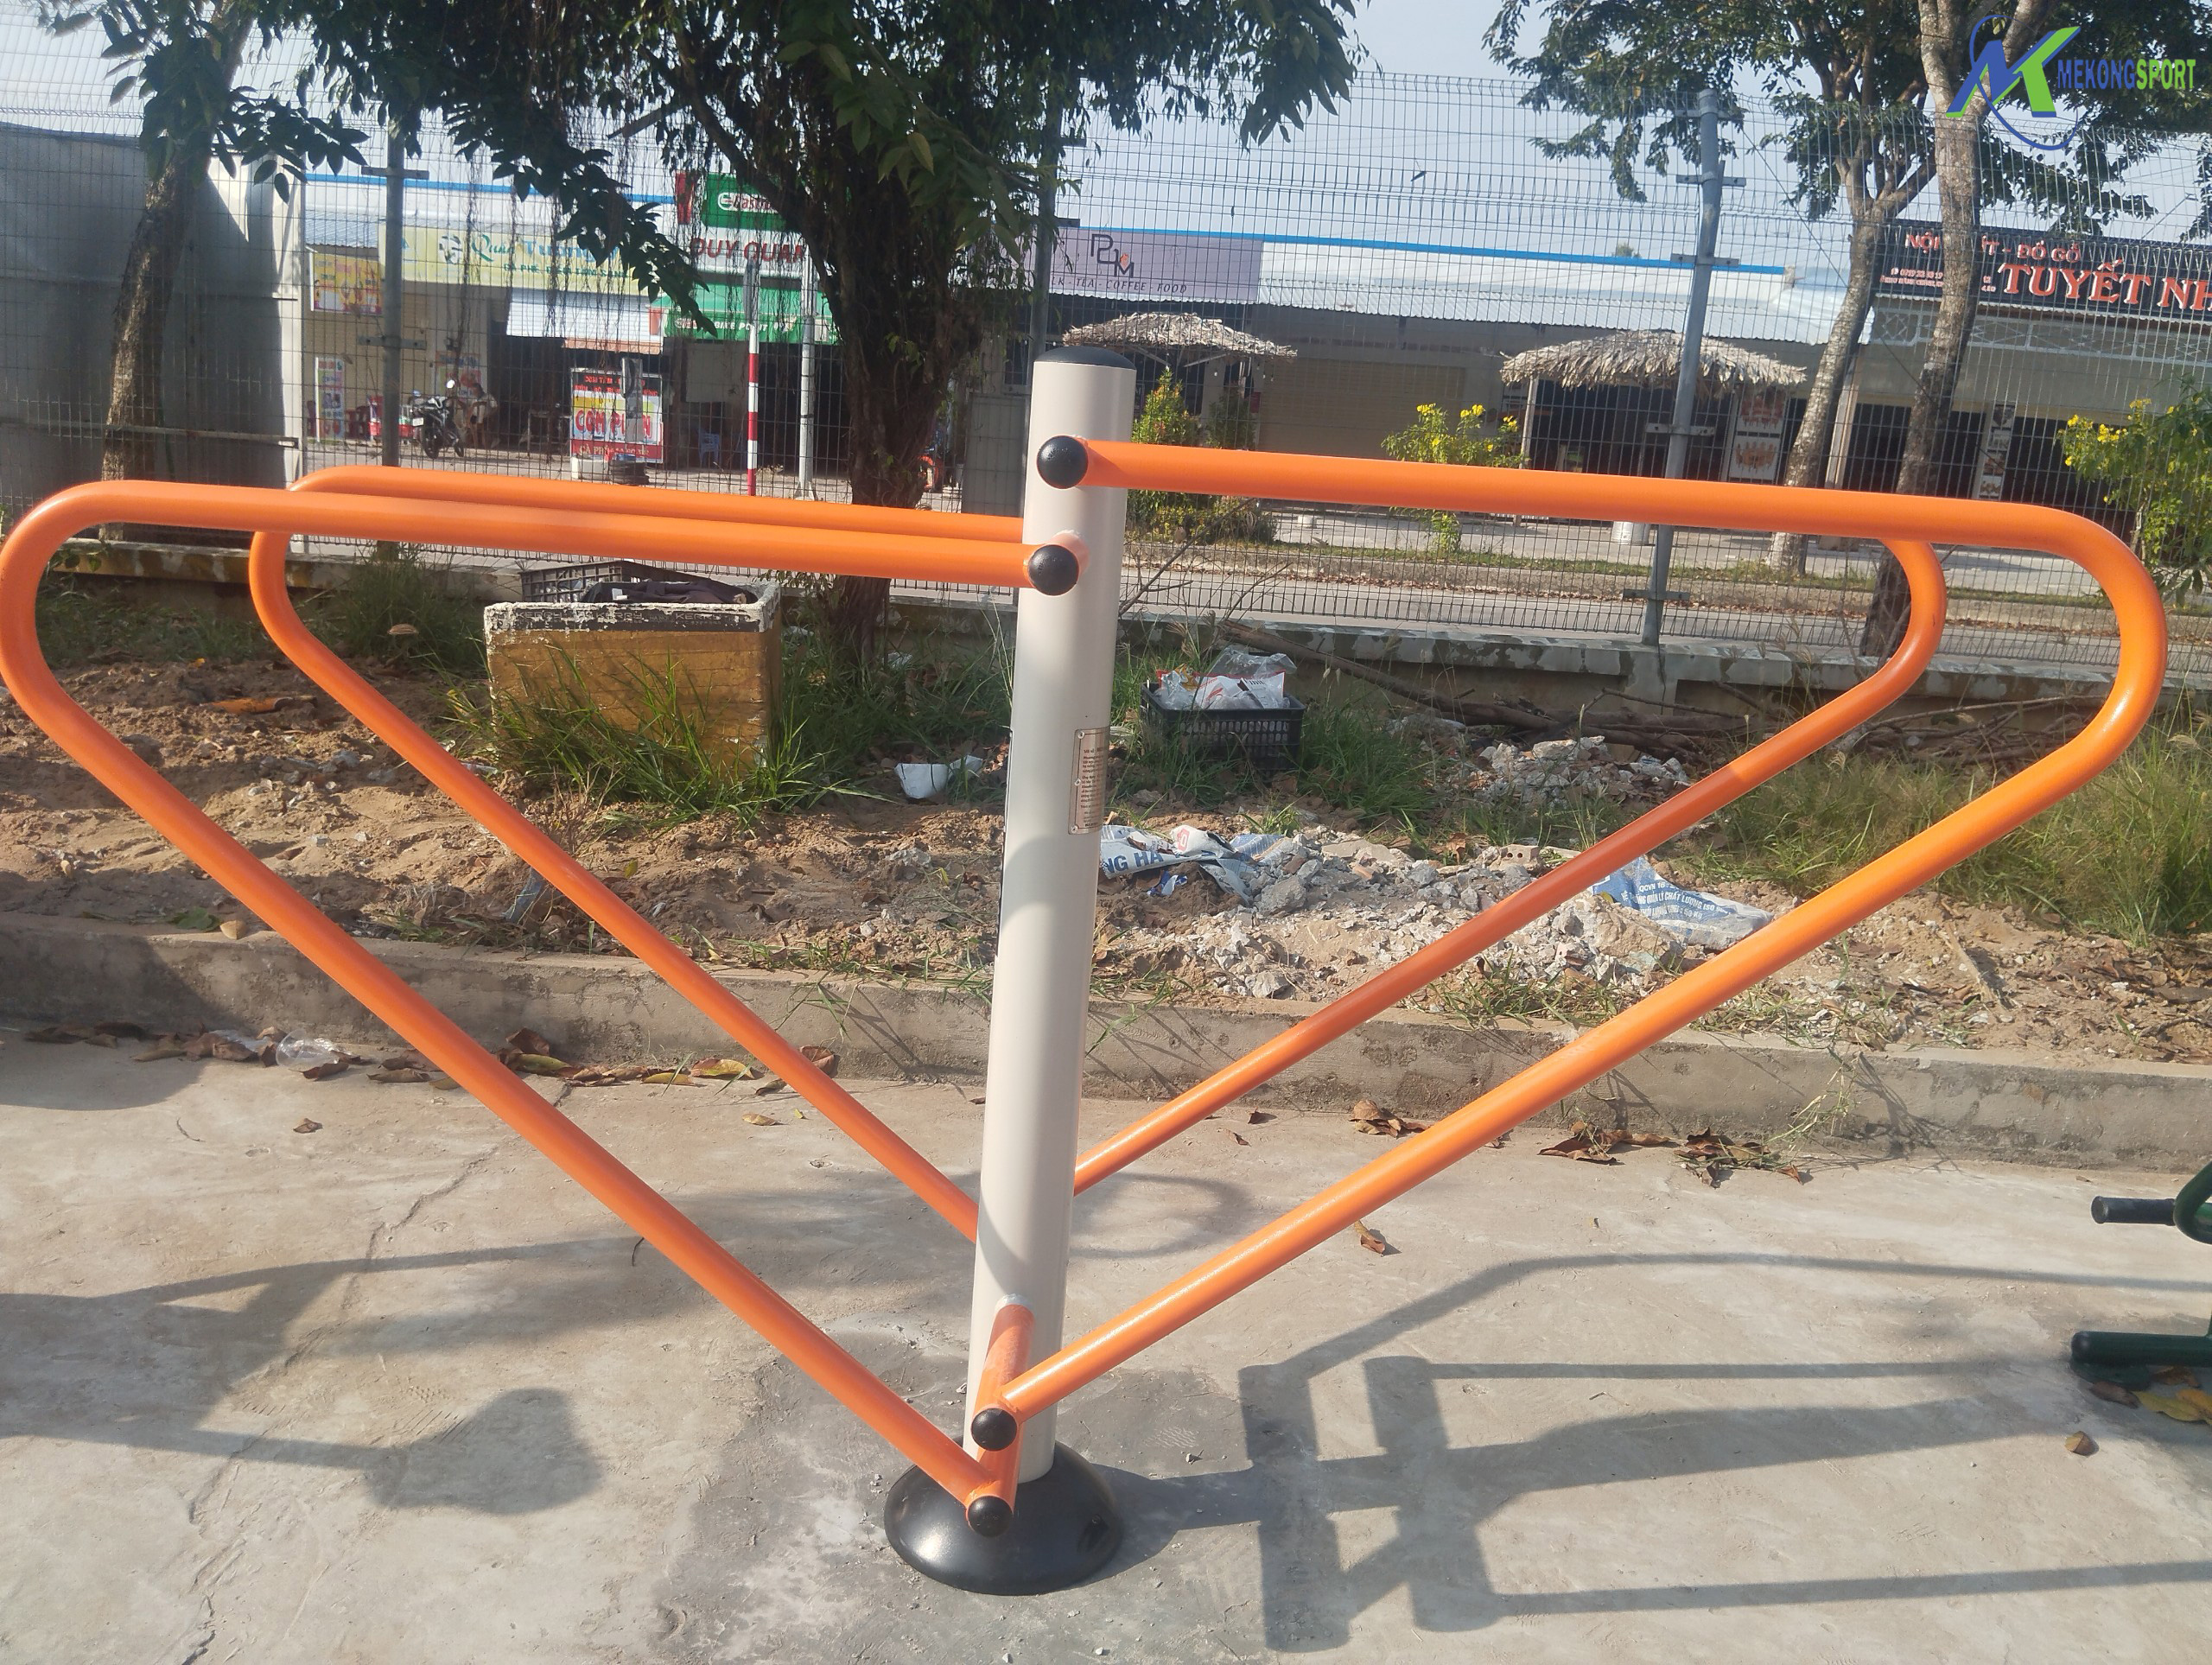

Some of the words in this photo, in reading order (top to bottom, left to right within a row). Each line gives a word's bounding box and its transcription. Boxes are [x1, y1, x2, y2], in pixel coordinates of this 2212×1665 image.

[1904, 230, 1940, 254] NỘI
[1077, 278, 1094, 288] TEA
[1106, 279, 1147, 291] COFFEE
[1157, 283, 1187, 294] FOOD
[1998, 257, 2151, 304] TUYẾT
